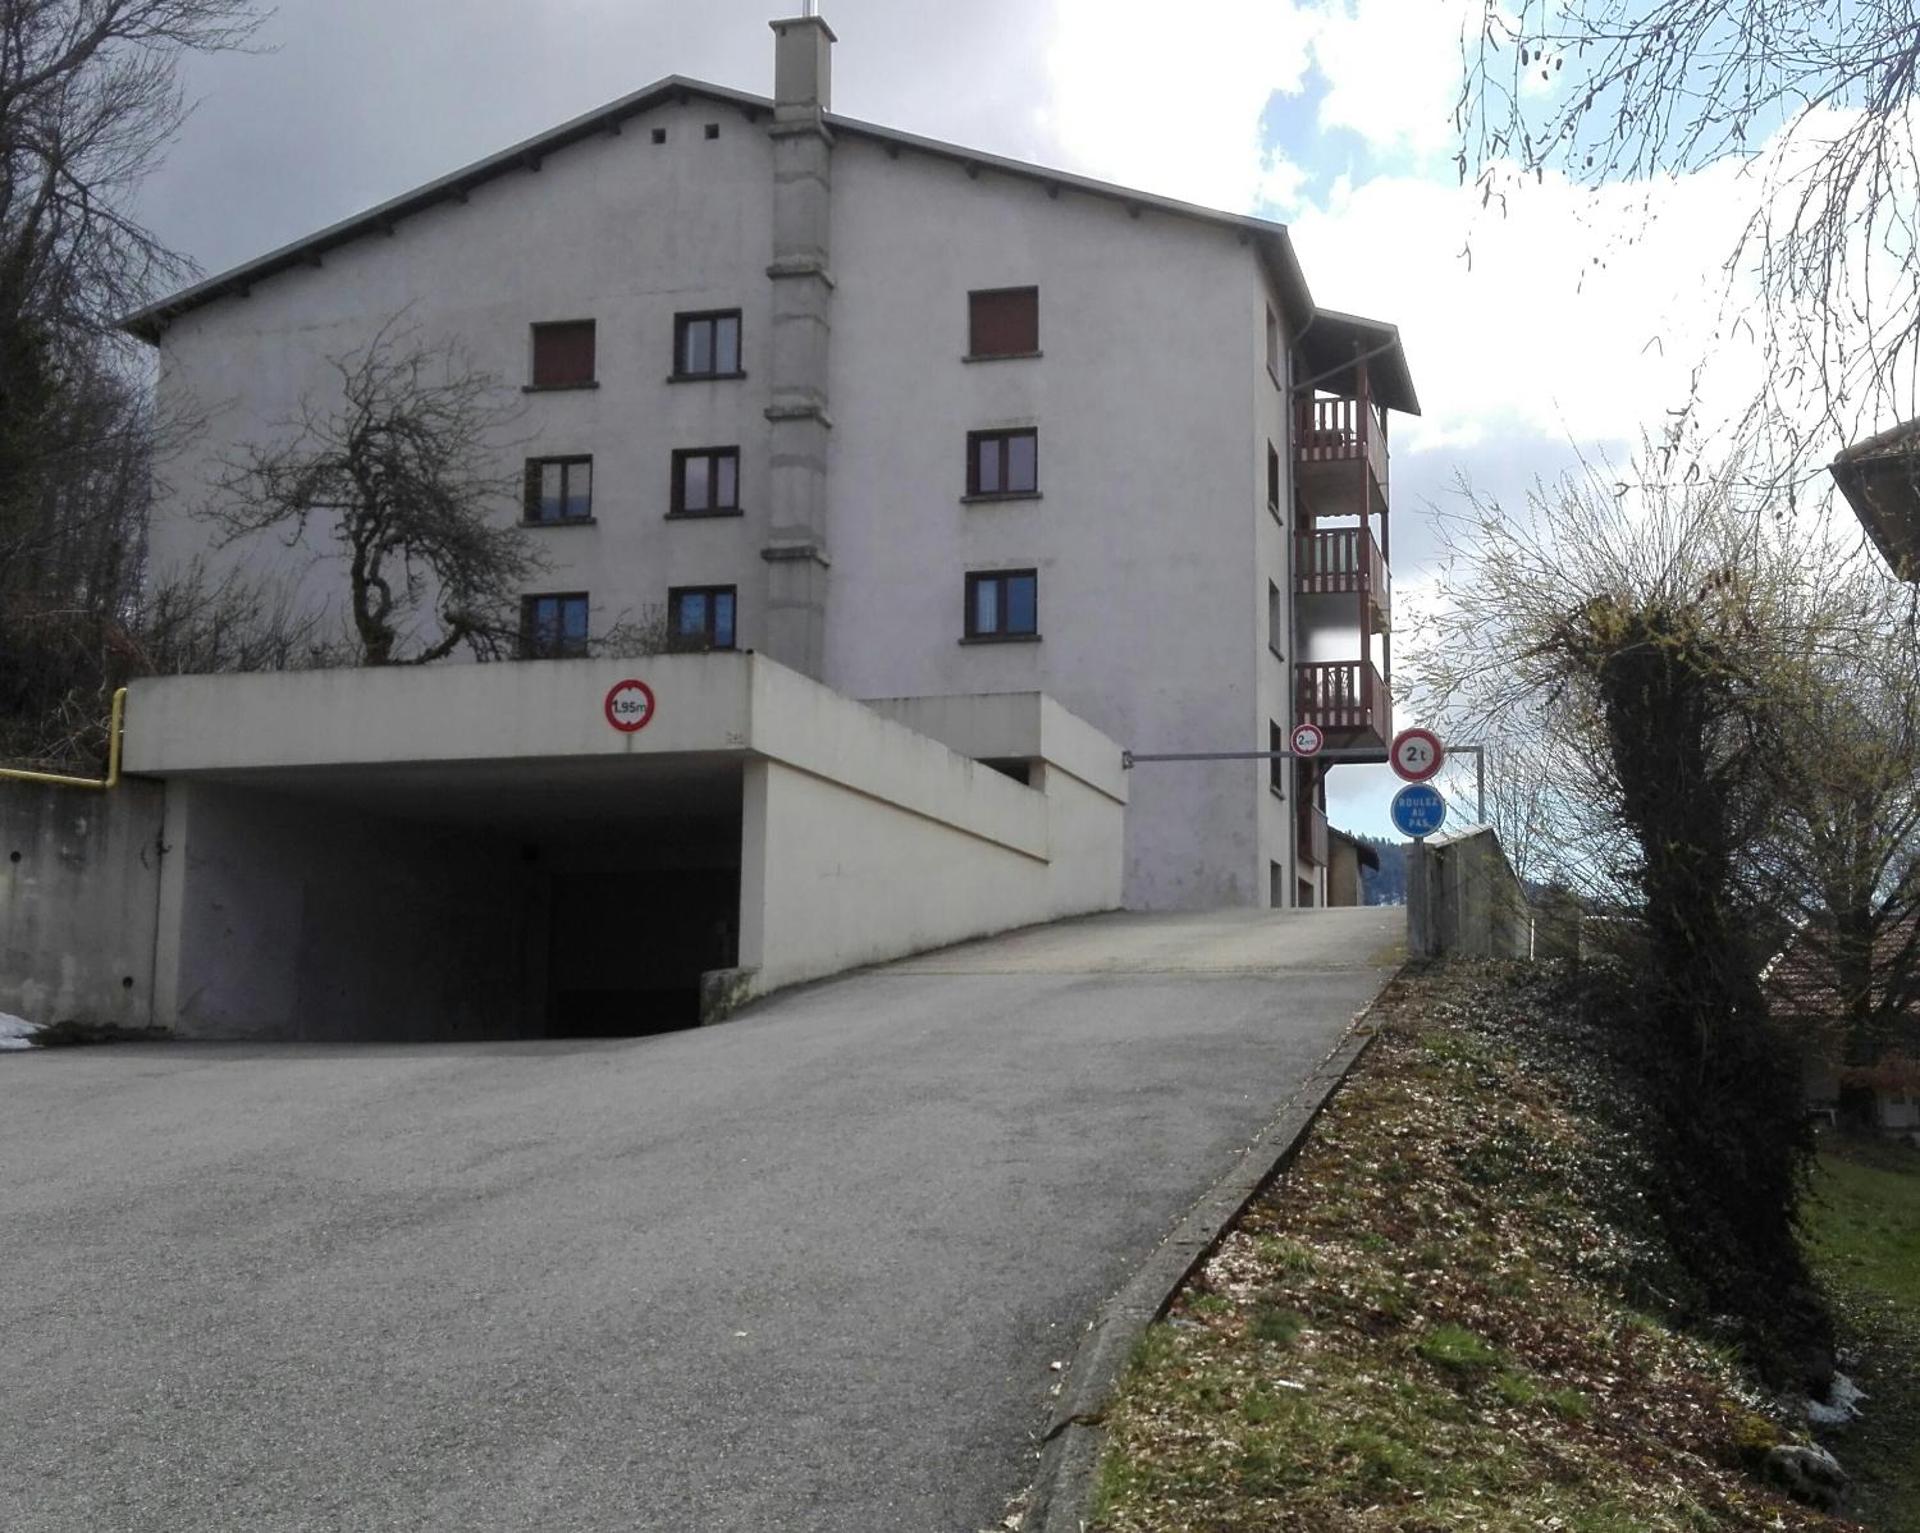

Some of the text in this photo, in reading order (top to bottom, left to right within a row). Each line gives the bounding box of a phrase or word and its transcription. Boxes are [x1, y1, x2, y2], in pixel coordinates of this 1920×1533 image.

[1398, 797, 1438, 807] ROULEZ
[1412, 808, 1425, 816] AU
[1408, 818, 1429, 828] PAS
